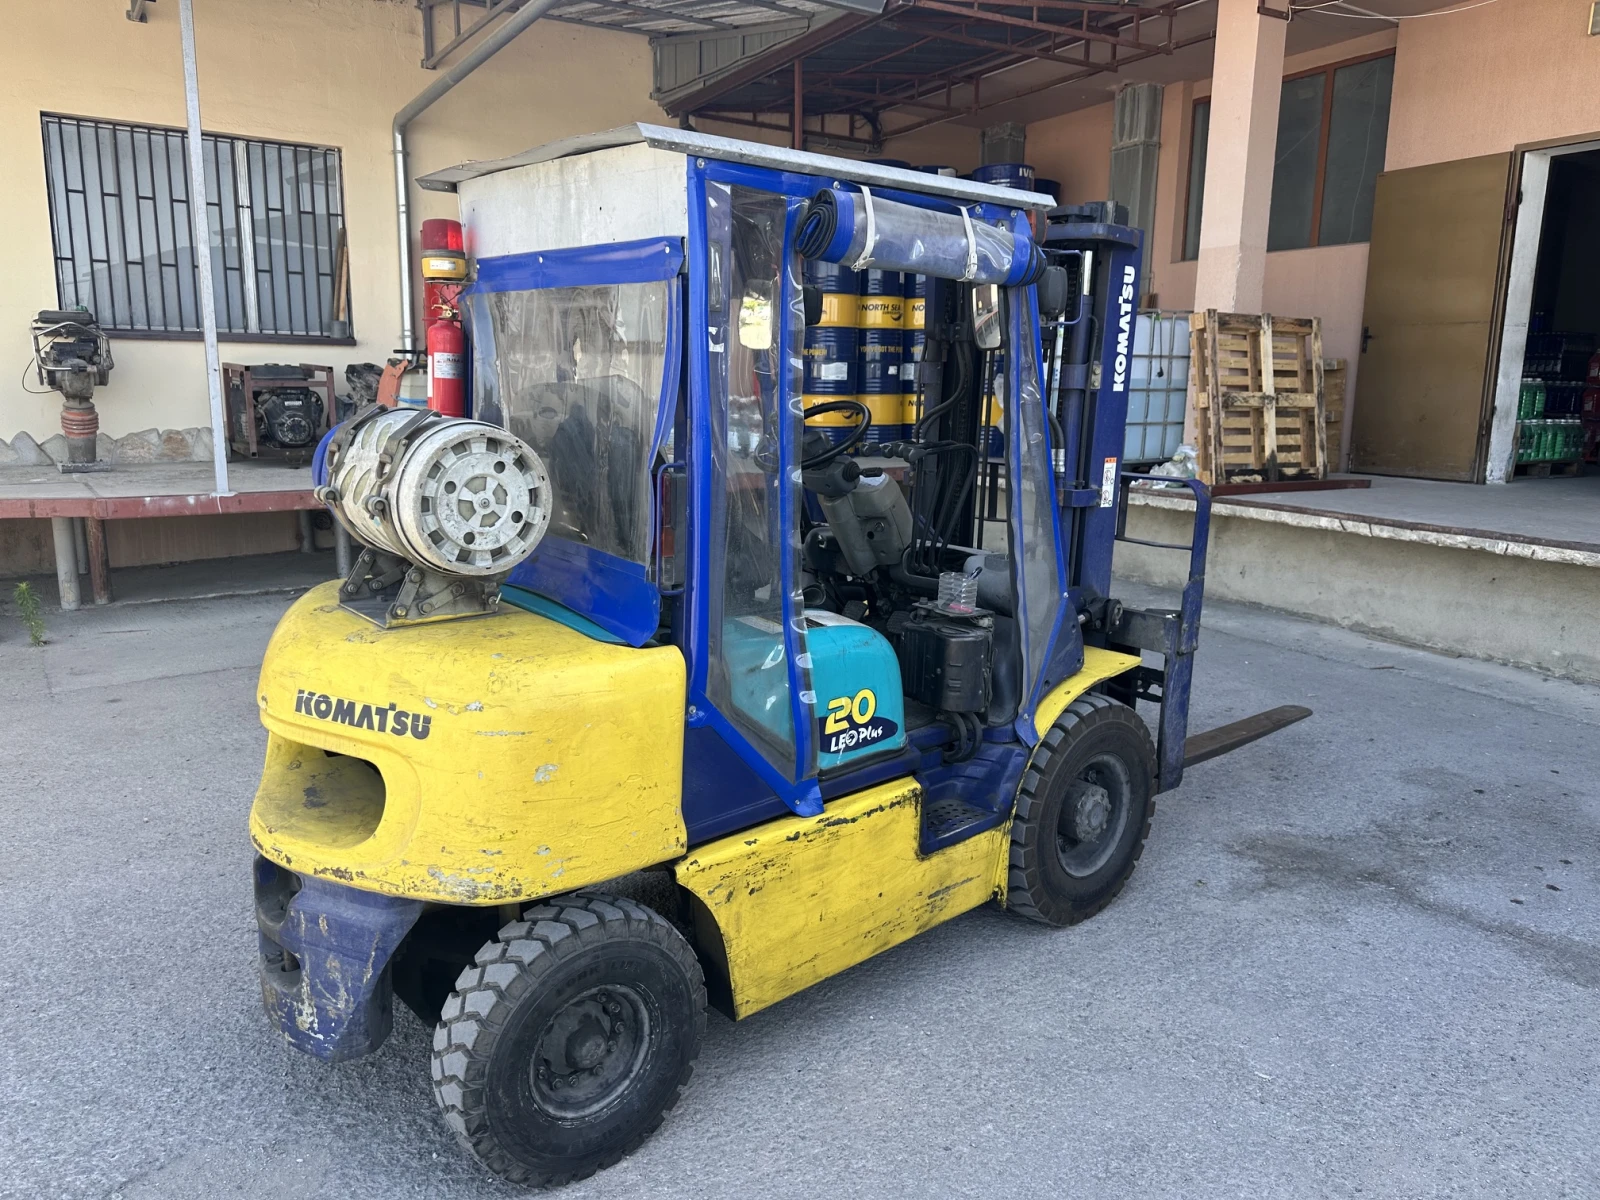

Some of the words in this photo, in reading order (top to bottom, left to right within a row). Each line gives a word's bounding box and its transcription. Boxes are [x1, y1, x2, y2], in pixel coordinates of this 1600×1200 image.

[861, 303, 889, 311] NORTH
[891, 303, 901, 311] SEA
[1112, 265, 1136, 392] KOMATSU
[295, 689, 432, 740] KOMATSU
[824, 688, 877, 735] 20
[830, 729, 858, 752] LEO
[858, 725, 883, 743] Plus
